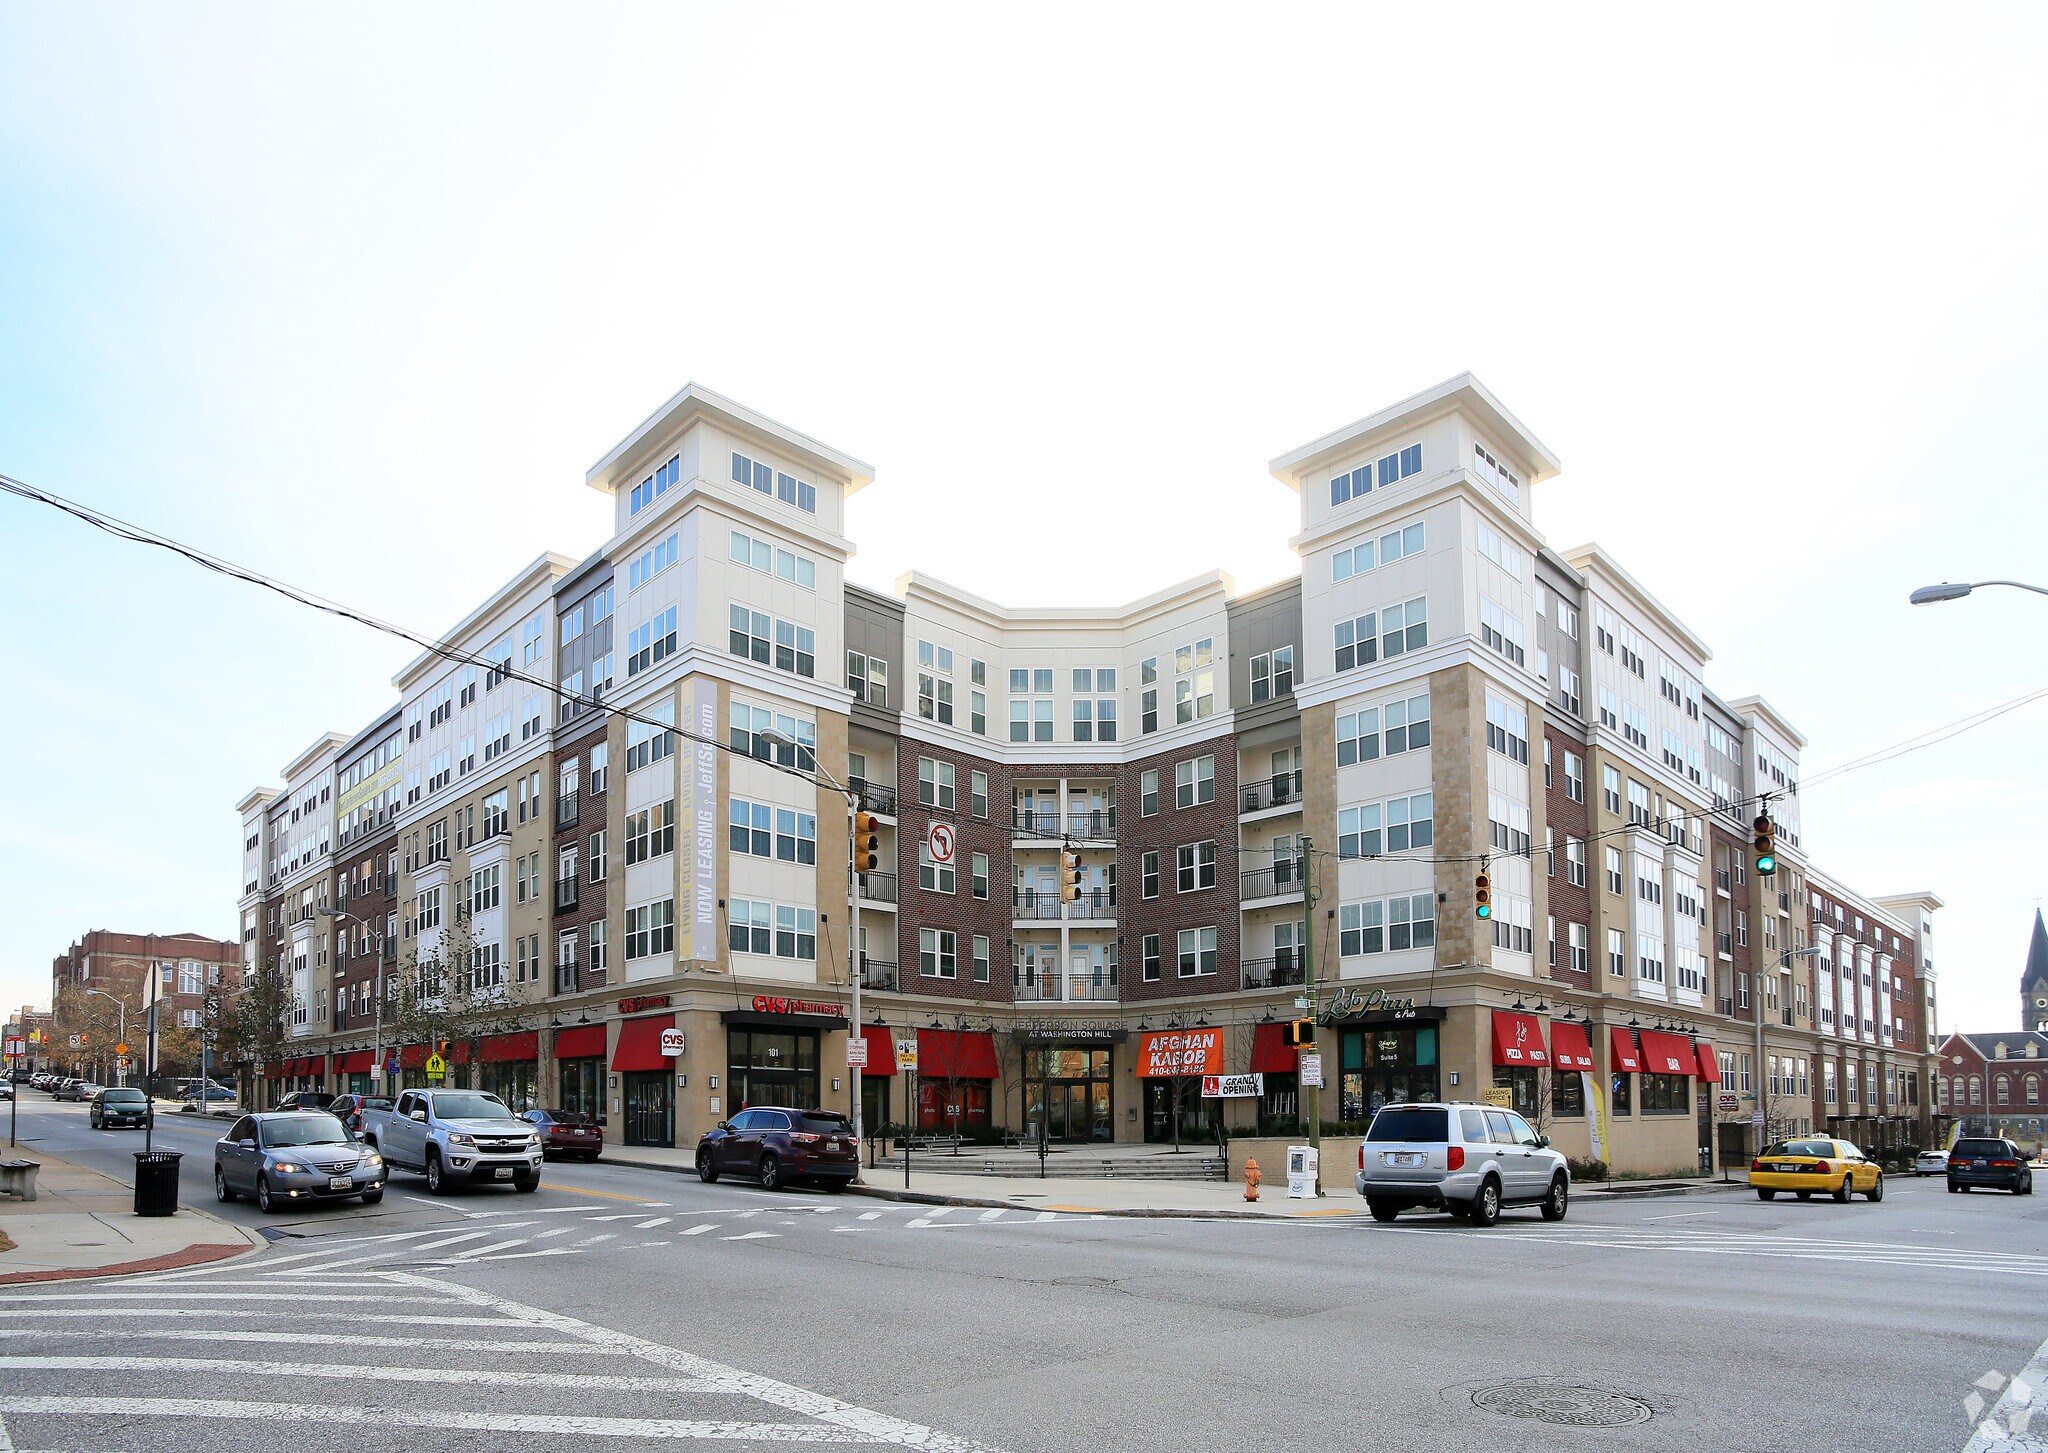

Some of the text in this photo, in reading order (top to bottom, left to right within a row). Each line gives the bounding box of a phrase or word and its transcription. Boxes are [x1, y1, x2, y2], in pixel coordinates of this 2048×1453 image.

[683, 704, 692, 759] BETER
[683, 764, 692, 809] LIVING
[697, 703, 713, 924] NOW LEASING JeffSqcom
[682, 830, 691, 884] CLOSER
[682, 889, 691, 935] LIVING
[752, 995, 845, 1018] CVS/pharmacy
[1319, 987, 1362, 1025] Ledo
[1401, 1008, 1416, 1019] Pub
[1081, 1020, 1129, 1031] SQUARE
[662, 1034, 684, 1045] CVS
[1040, 1030, 1093, 1039] WASHINGTON
[1094, 1030, 1112, 1038] HILL
[1147, 1033, 1215, 1052] AFGHAN
[768, 1048, 779, 1057] 101
[1150, 1050, 1206, 1067] KABOB
[1506, 1048, 1546, 1061] PIZZA PASTA
[1560, 1055, 1592, 1066] SUBS SALAD
[1667, 1057, 1681, 1071] BAR
[1225, 1077, 1254, 1086] GRAND
[1223, 1084, 1259, 1095] OPENING
